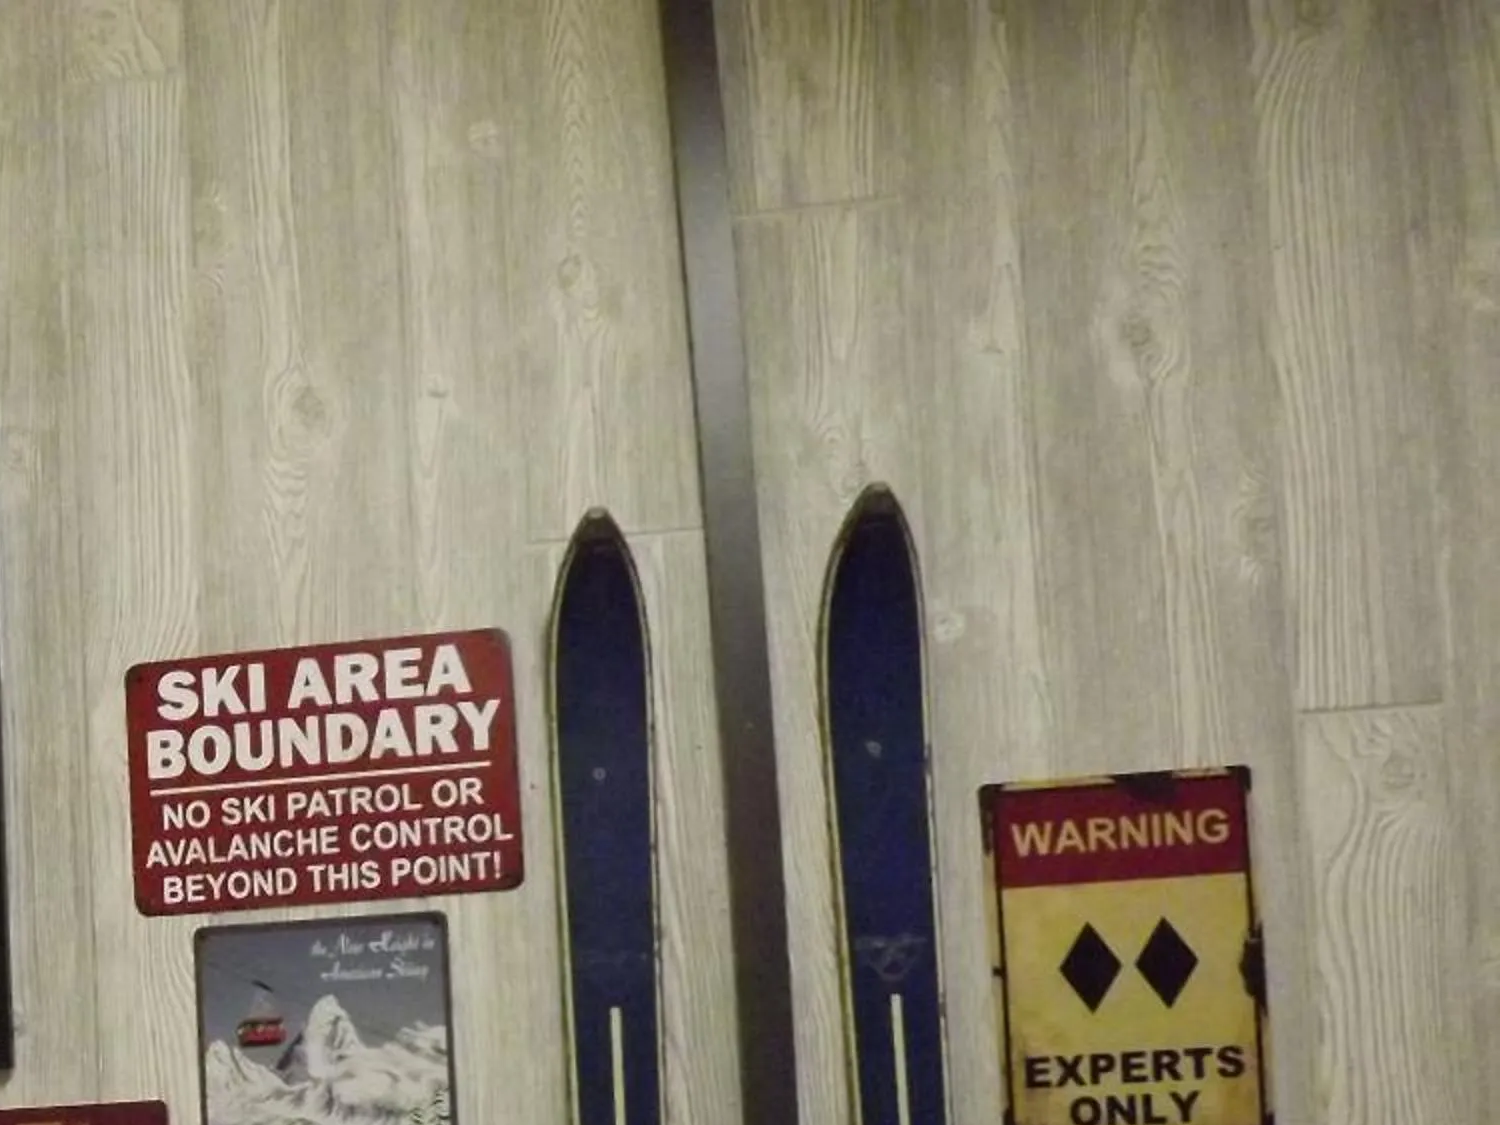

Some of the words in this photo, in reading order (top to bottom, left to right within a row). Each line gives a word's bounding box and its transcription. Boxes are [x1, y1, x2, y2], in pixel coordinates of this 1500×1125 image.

[157, 663, 266, 721] SKI
[288, 644, 472, 709] AREA
[147, 700, 500, 779] BOUNDARY
[163, 803, 210, 830] NO
[221, 794, 275, 825] SKI
[288, 784, 422, 820] PATROL
[432, 777, 484, 808] OR
[146, 826, 339, 868] AVALANCHE
[350, 813, 514, 851] CONTROL
[1011, 808, 1229, 857] WARNING
[163, 867, 297, 904] BEYOND
[308, 858, 381, 893] THIS
[391, 851, 501, 886] POINT!
[1025, 1046, 1244, 1089] EXPERTS
